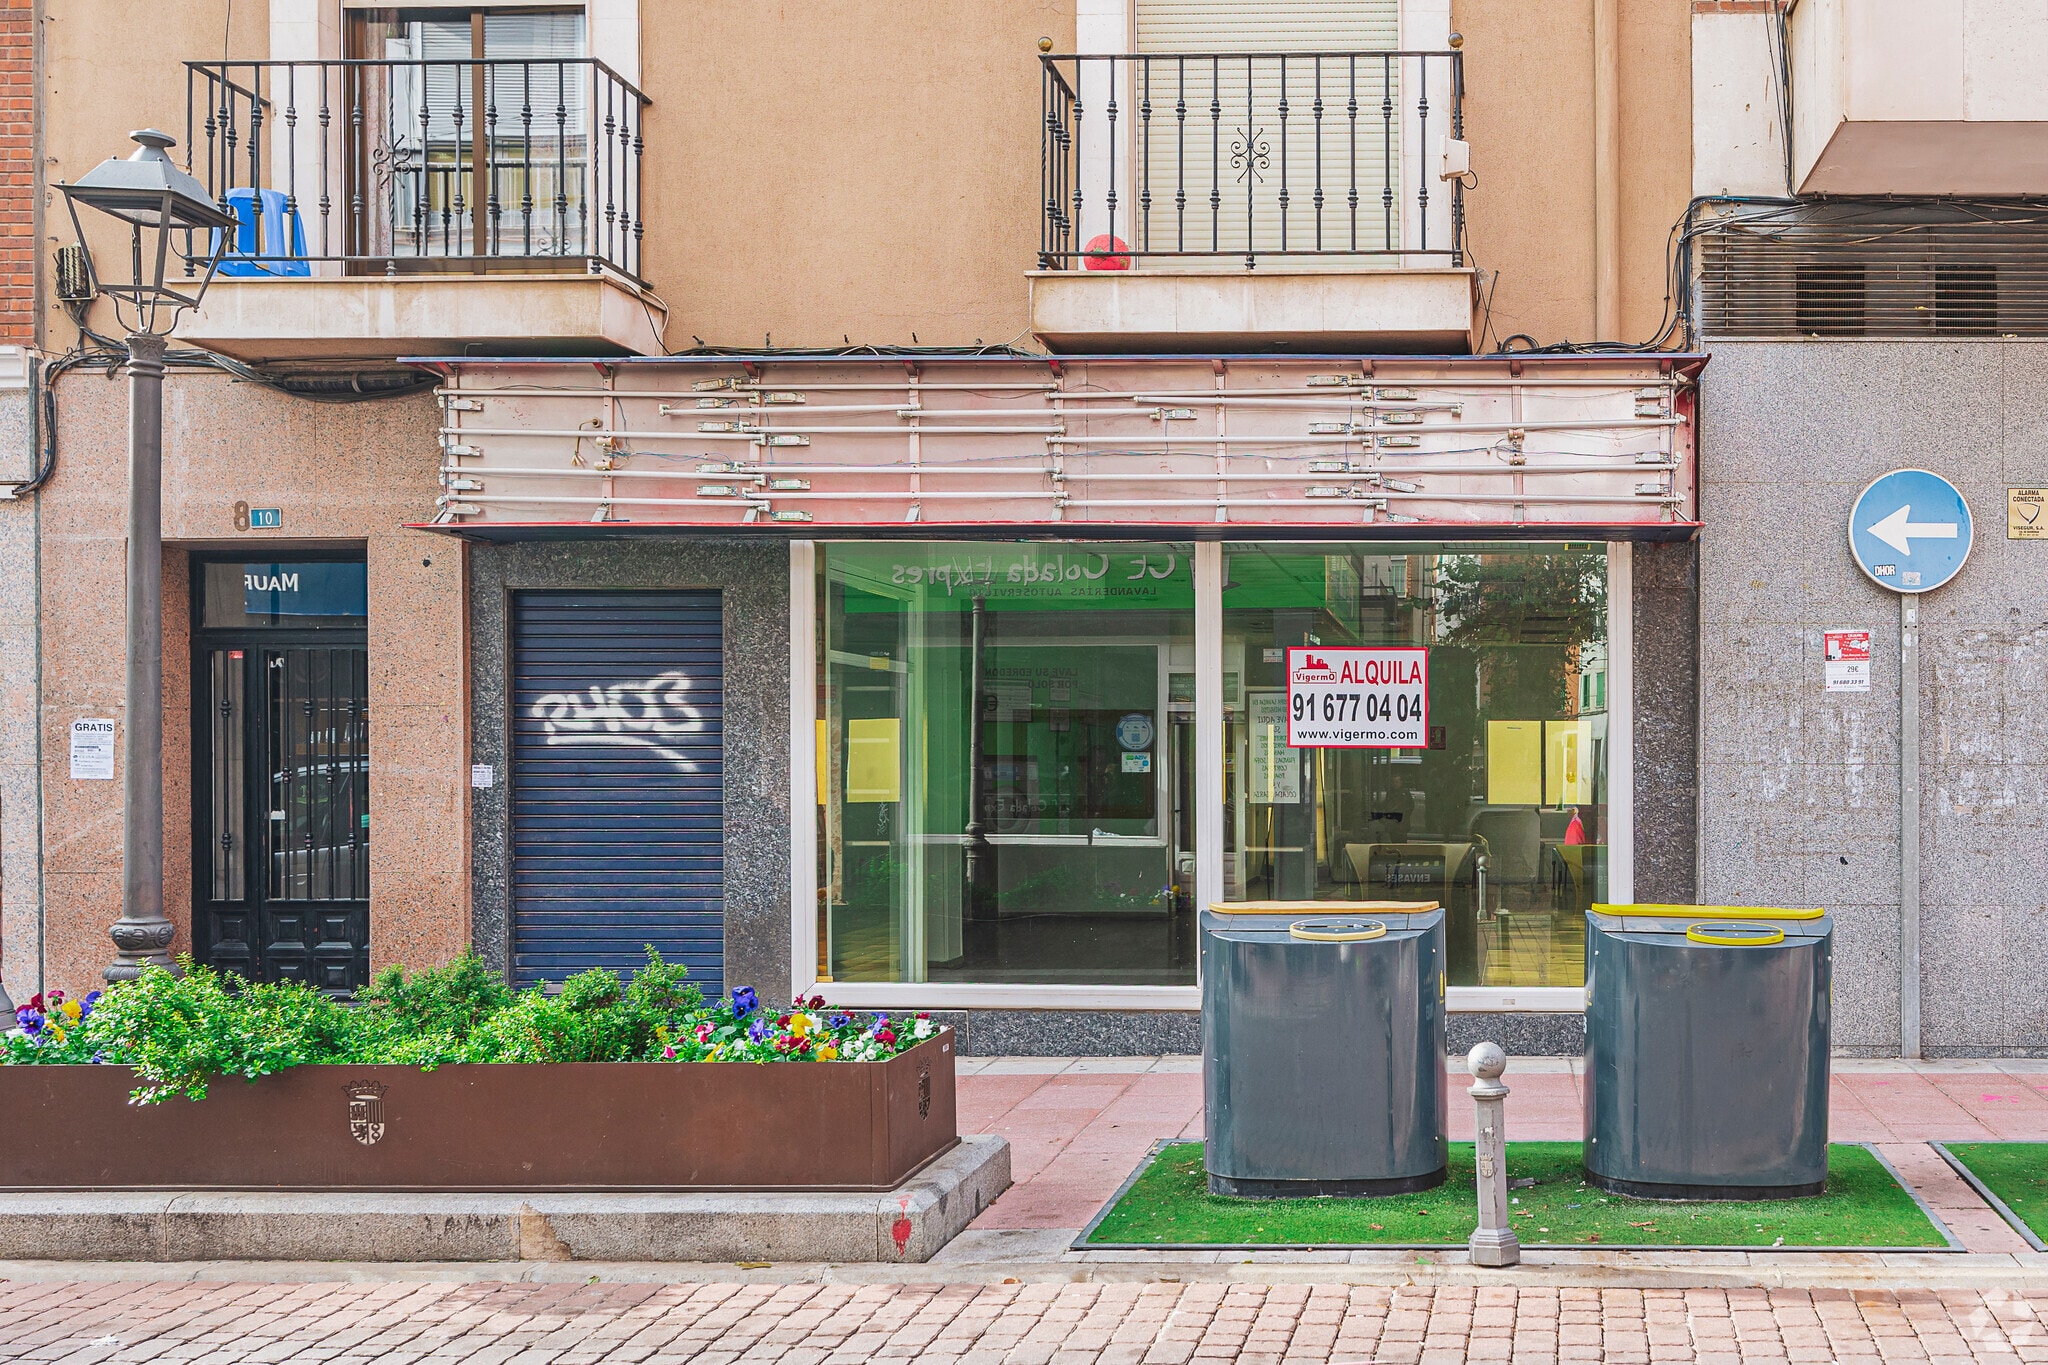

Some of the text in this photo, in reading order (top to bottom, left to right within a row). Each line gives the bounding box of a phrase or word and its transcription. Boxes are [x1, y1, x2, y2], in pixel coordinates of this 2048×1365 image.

[234, 500, 250, 531] 8
[258, 511, 273, 525] 10
[1874, 565, 1895, 577] DHOR
[1340, 660, 1422, 686] ALQUILA
[1293, 693, 1422, 722] 91 677 04 04
[74, 722, 113, 732] GRATIS
[1297, 729, 1418, 742] www.vigermo.com
